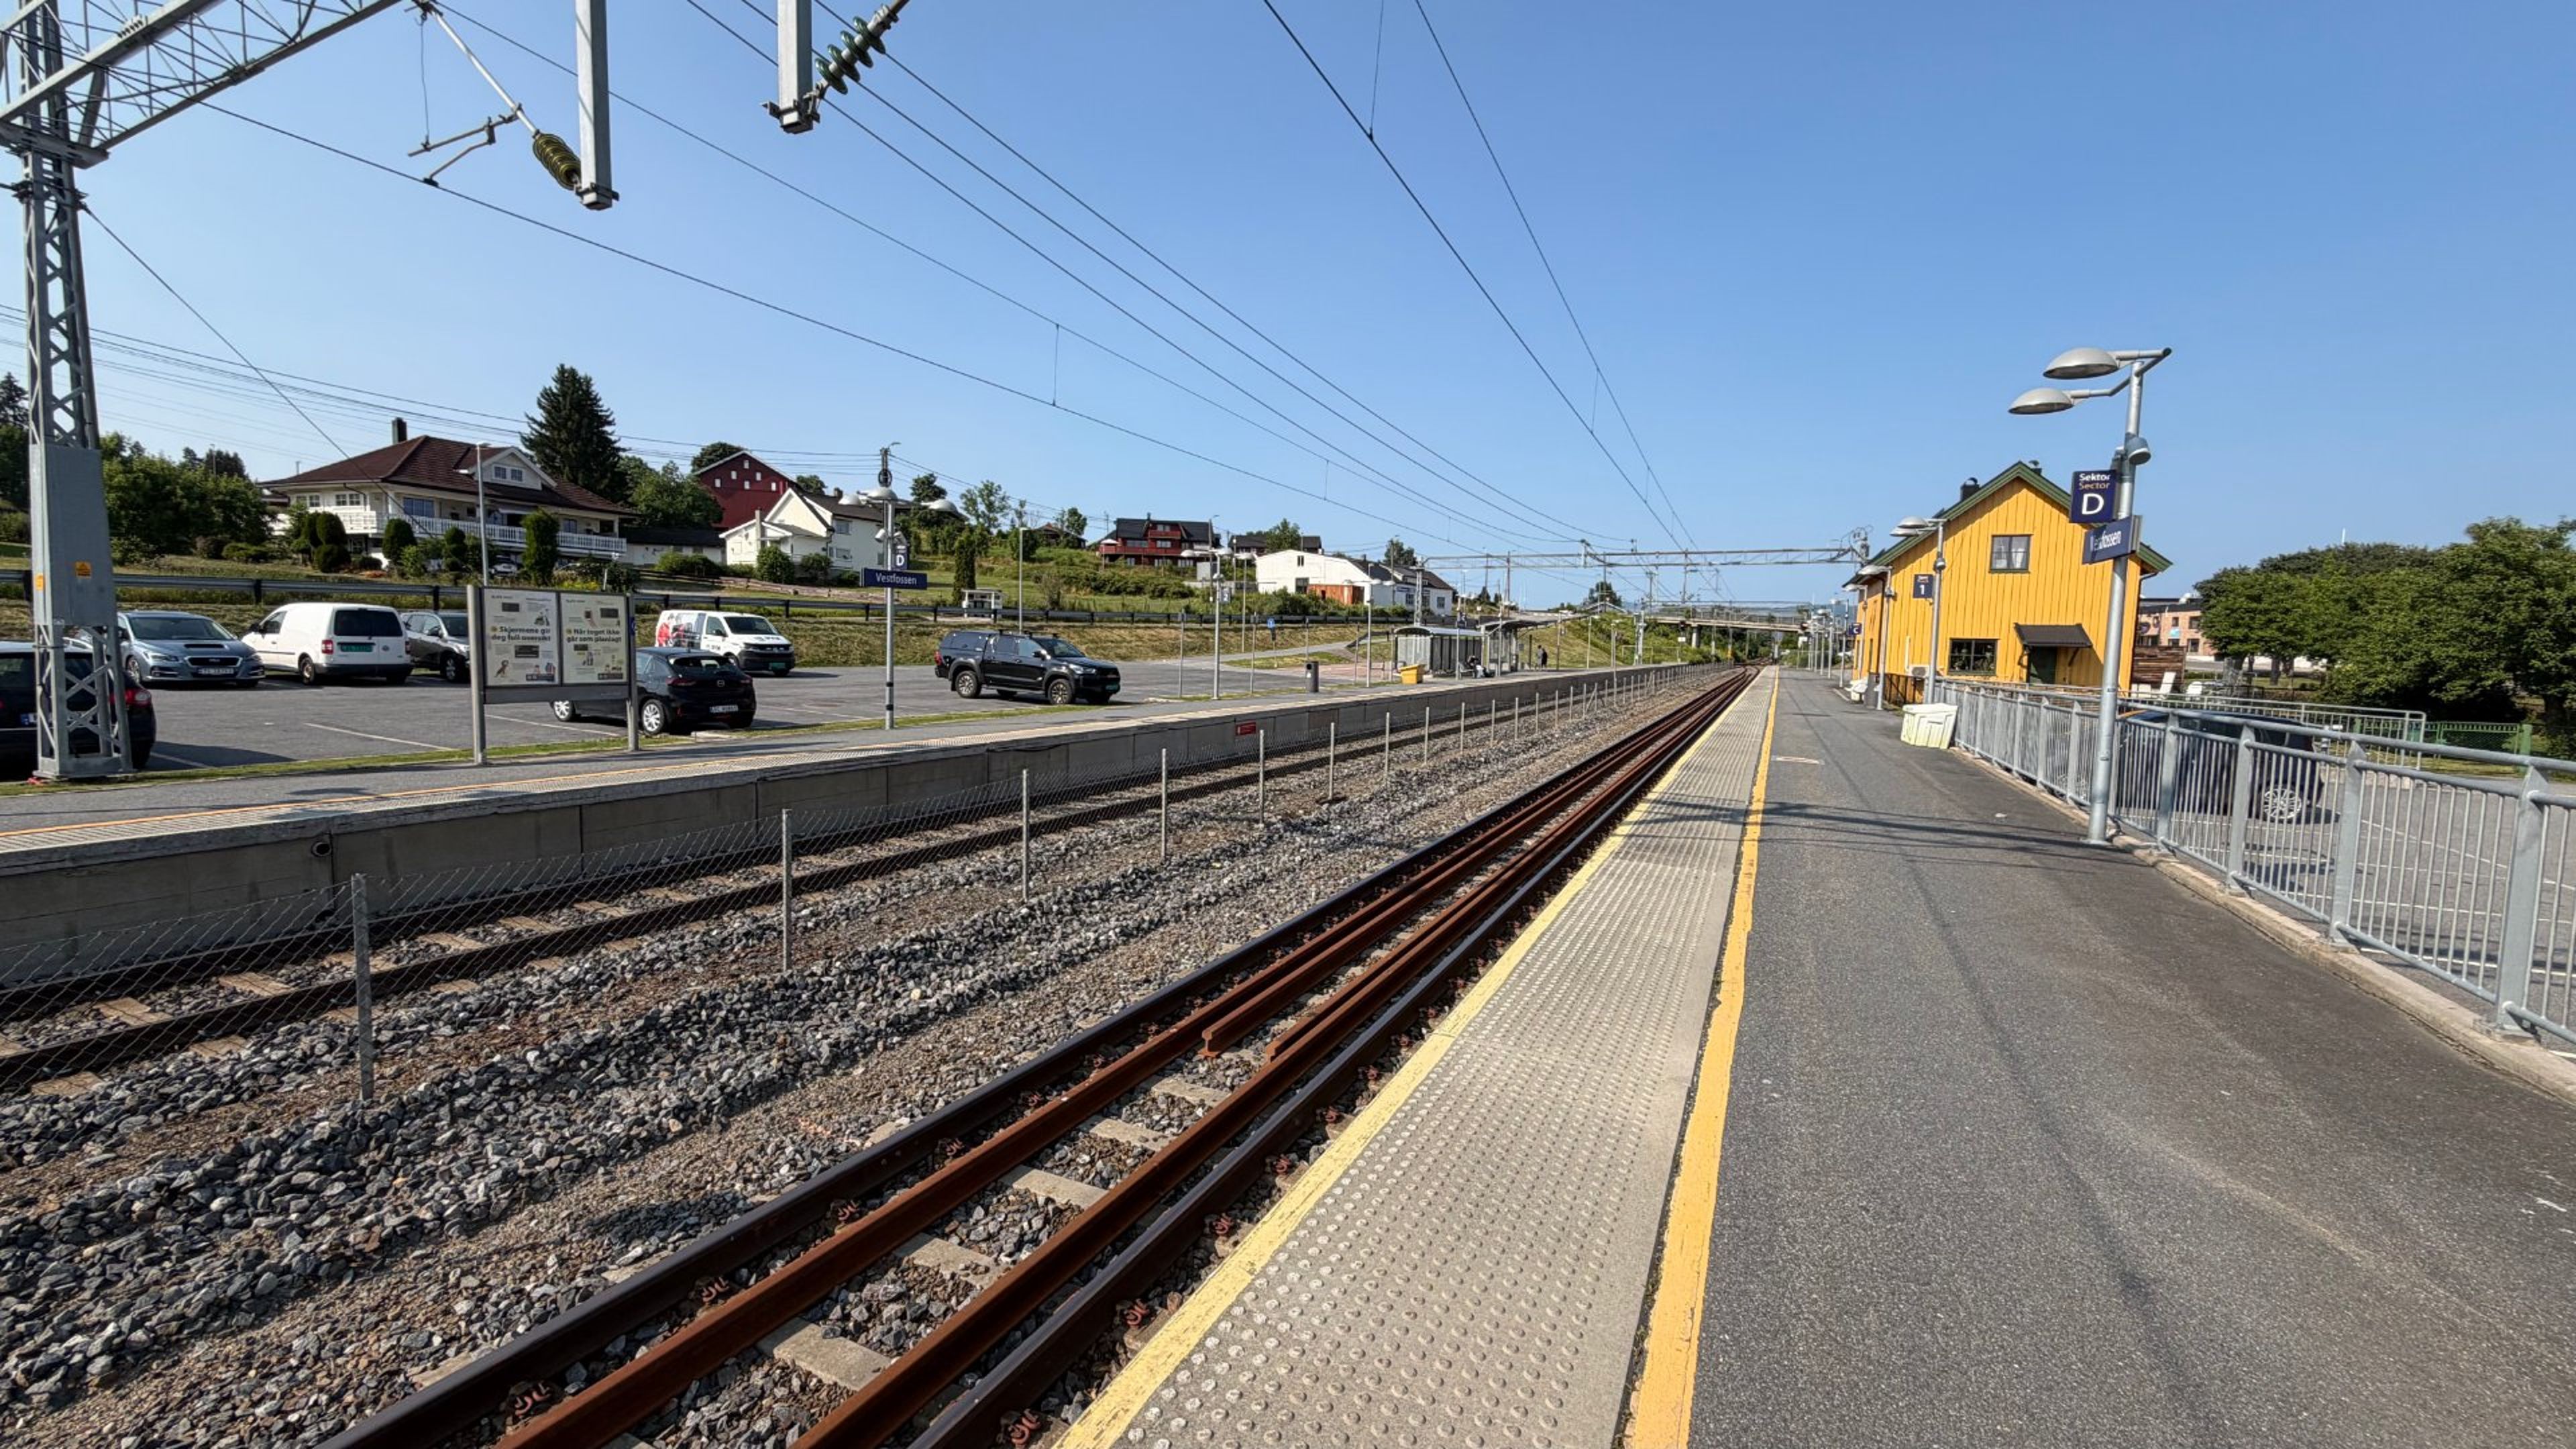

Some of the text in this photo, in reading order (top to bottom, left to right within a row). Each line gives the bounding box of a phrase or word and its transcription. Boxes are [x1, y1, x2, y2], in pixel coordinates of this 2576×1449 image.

[2079, 473, 2110, 481] Sektor
[2079, 482, 2110, 490] Sector
[2082, 493, 2104, 515] D
[896, 554, 904, 566] D
[875, 572, 917, 585] Vestfossen
[1919, 584, 1925, 595] 1
[499, 626, 539, 635] Skjermene
